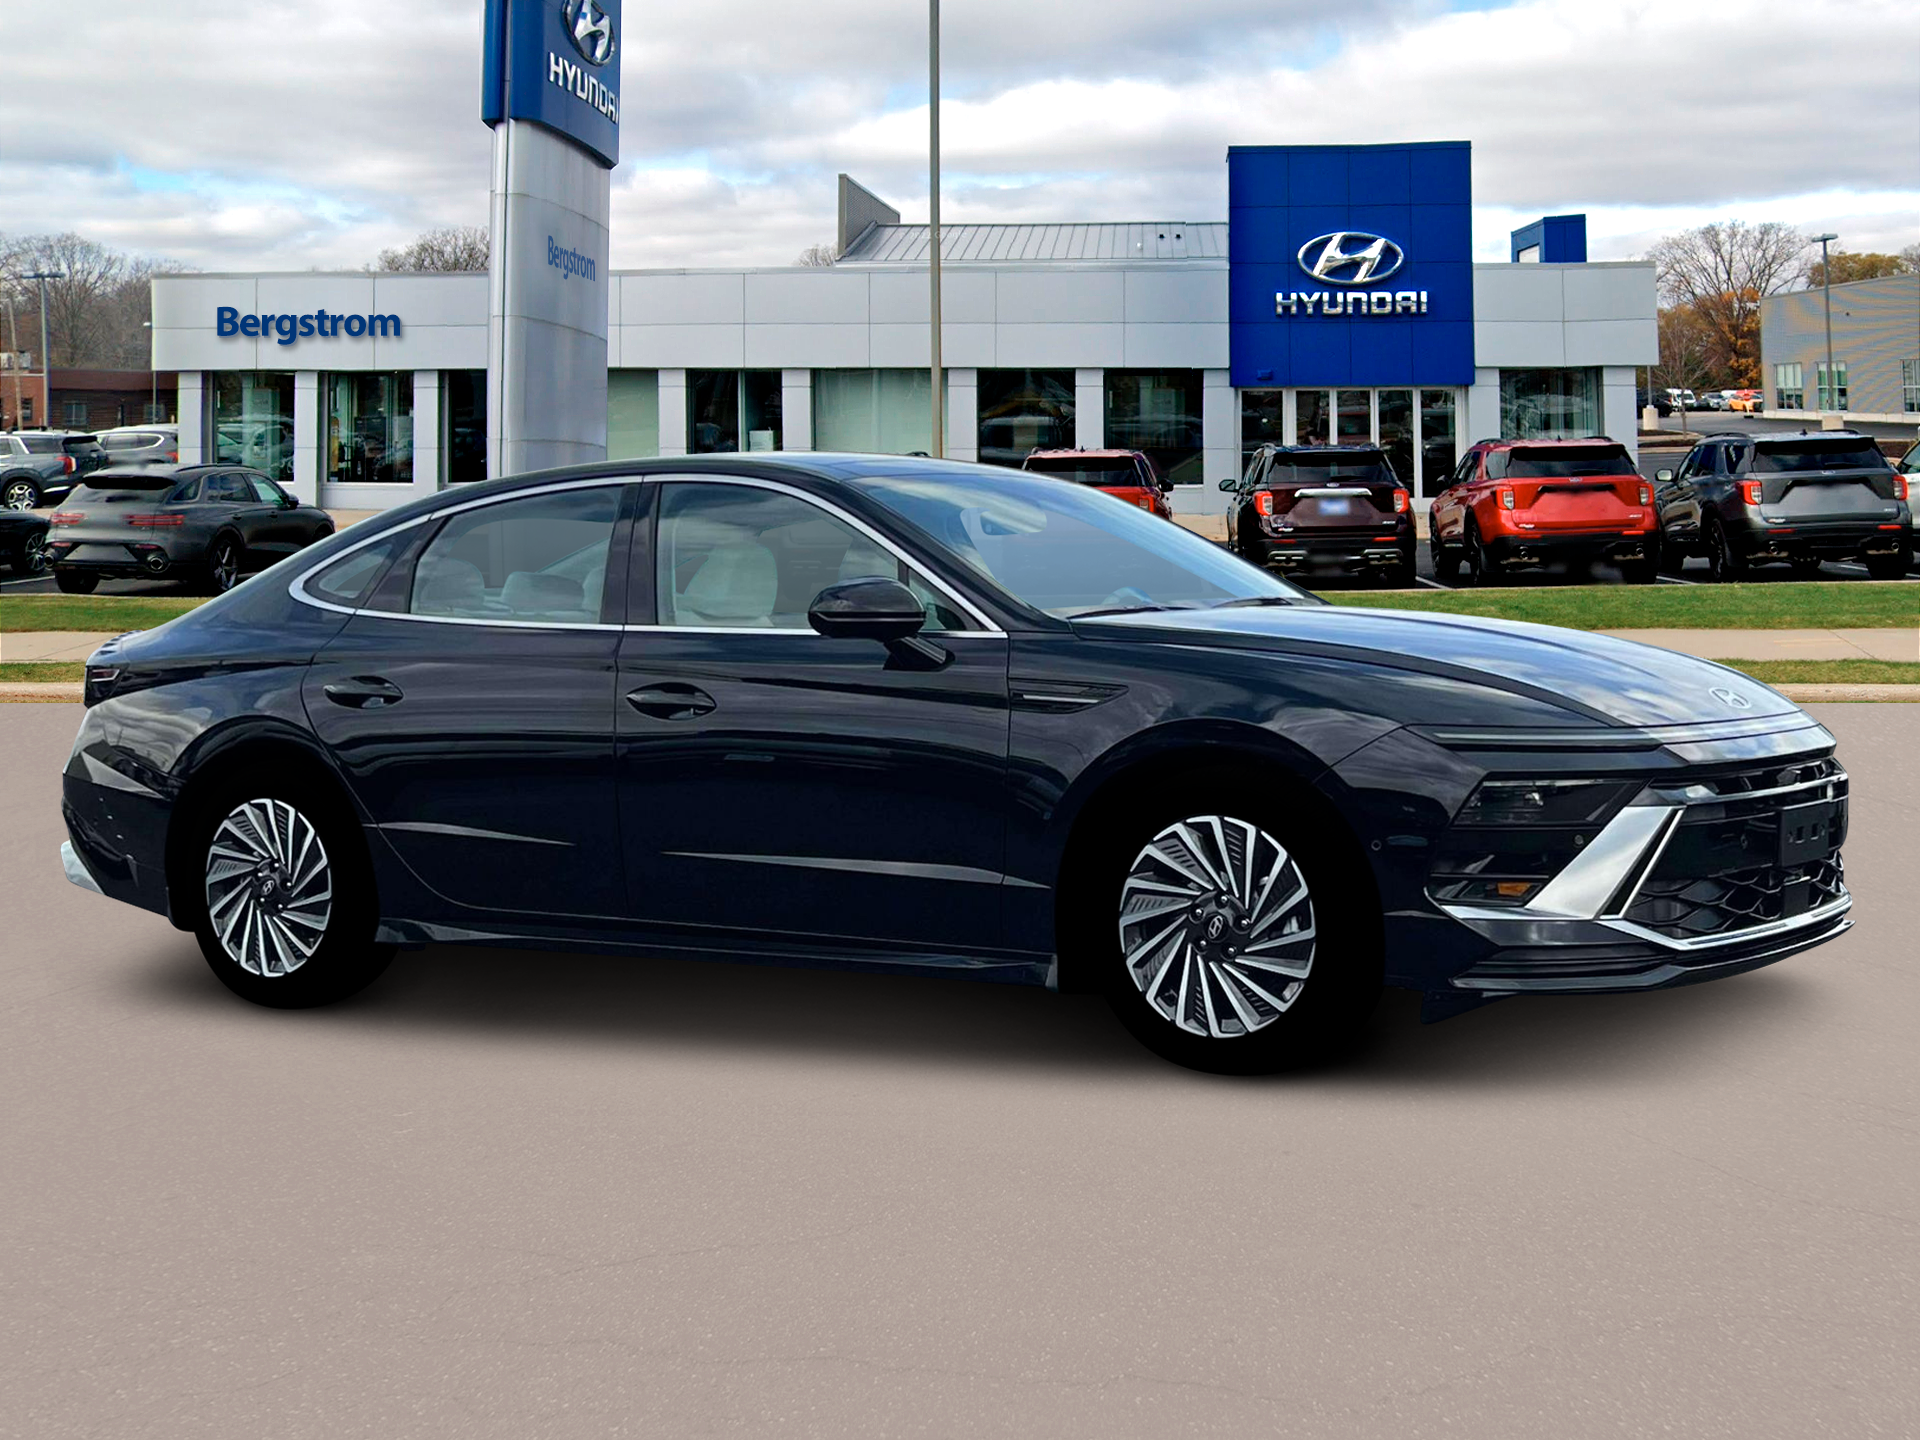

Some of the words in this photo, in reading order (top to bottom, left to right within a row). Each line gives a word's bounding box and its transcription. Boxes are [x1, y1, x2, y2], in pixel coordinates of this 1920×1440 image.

[549, 52, 619, 125] HYUNDAI
[547, 235, 596, 282] Bergstrom
[1275, 290, 1428, 316] HYUNDAI
[216, 306, 401, 346] Bergstrom
